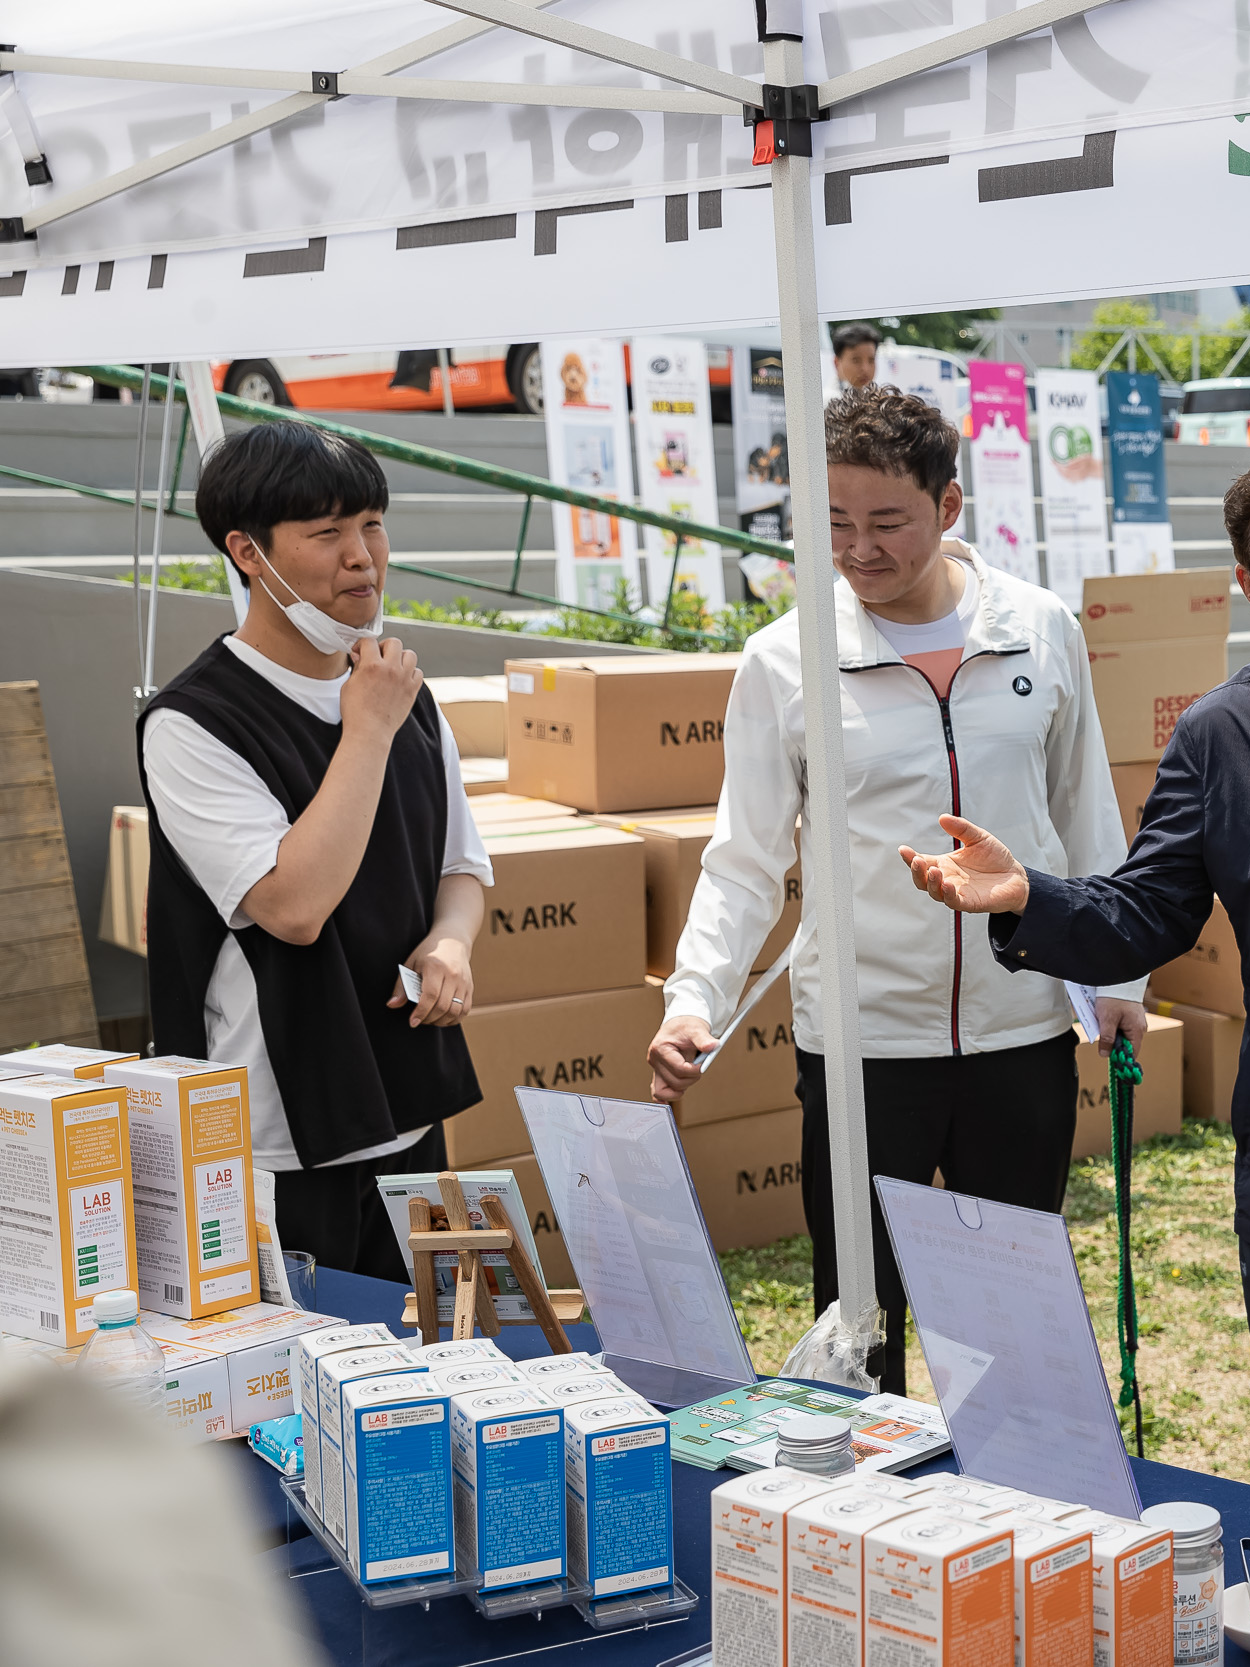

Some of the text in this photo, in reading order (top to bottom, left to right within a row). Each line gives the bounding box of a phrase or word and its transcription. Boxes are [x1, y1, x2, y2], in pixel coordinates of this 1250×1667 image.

[746, 1021, 796, 1051] NA
[13, 1109, 36, 1128] 펫치즈
[206, 1168, 232, 1186] LAB
[207, 1182, 233, 1192] SOLUTION
[83, 1191, 111, 1210] LAB
[84, 1206, 111, 1216] SOLUTION
[247, 1368, 290, 1396] 펫치즈
[166, 1391, 213, 1417] 짜먹는
[205, 1414, 225, 1423] SOLUTION
[368, 1413, 388, 1424] LAB
[205, 1420, 225, 1434] LAB
[488, 1425, 507, 1436] LAB
[597, 1438, 615, 1448] LAB
[954, 1558, 970, 1573] LAB
[1035, 1559, 1050, 1573] LAB
[1123, 1558, 1137, 1572] LAB
